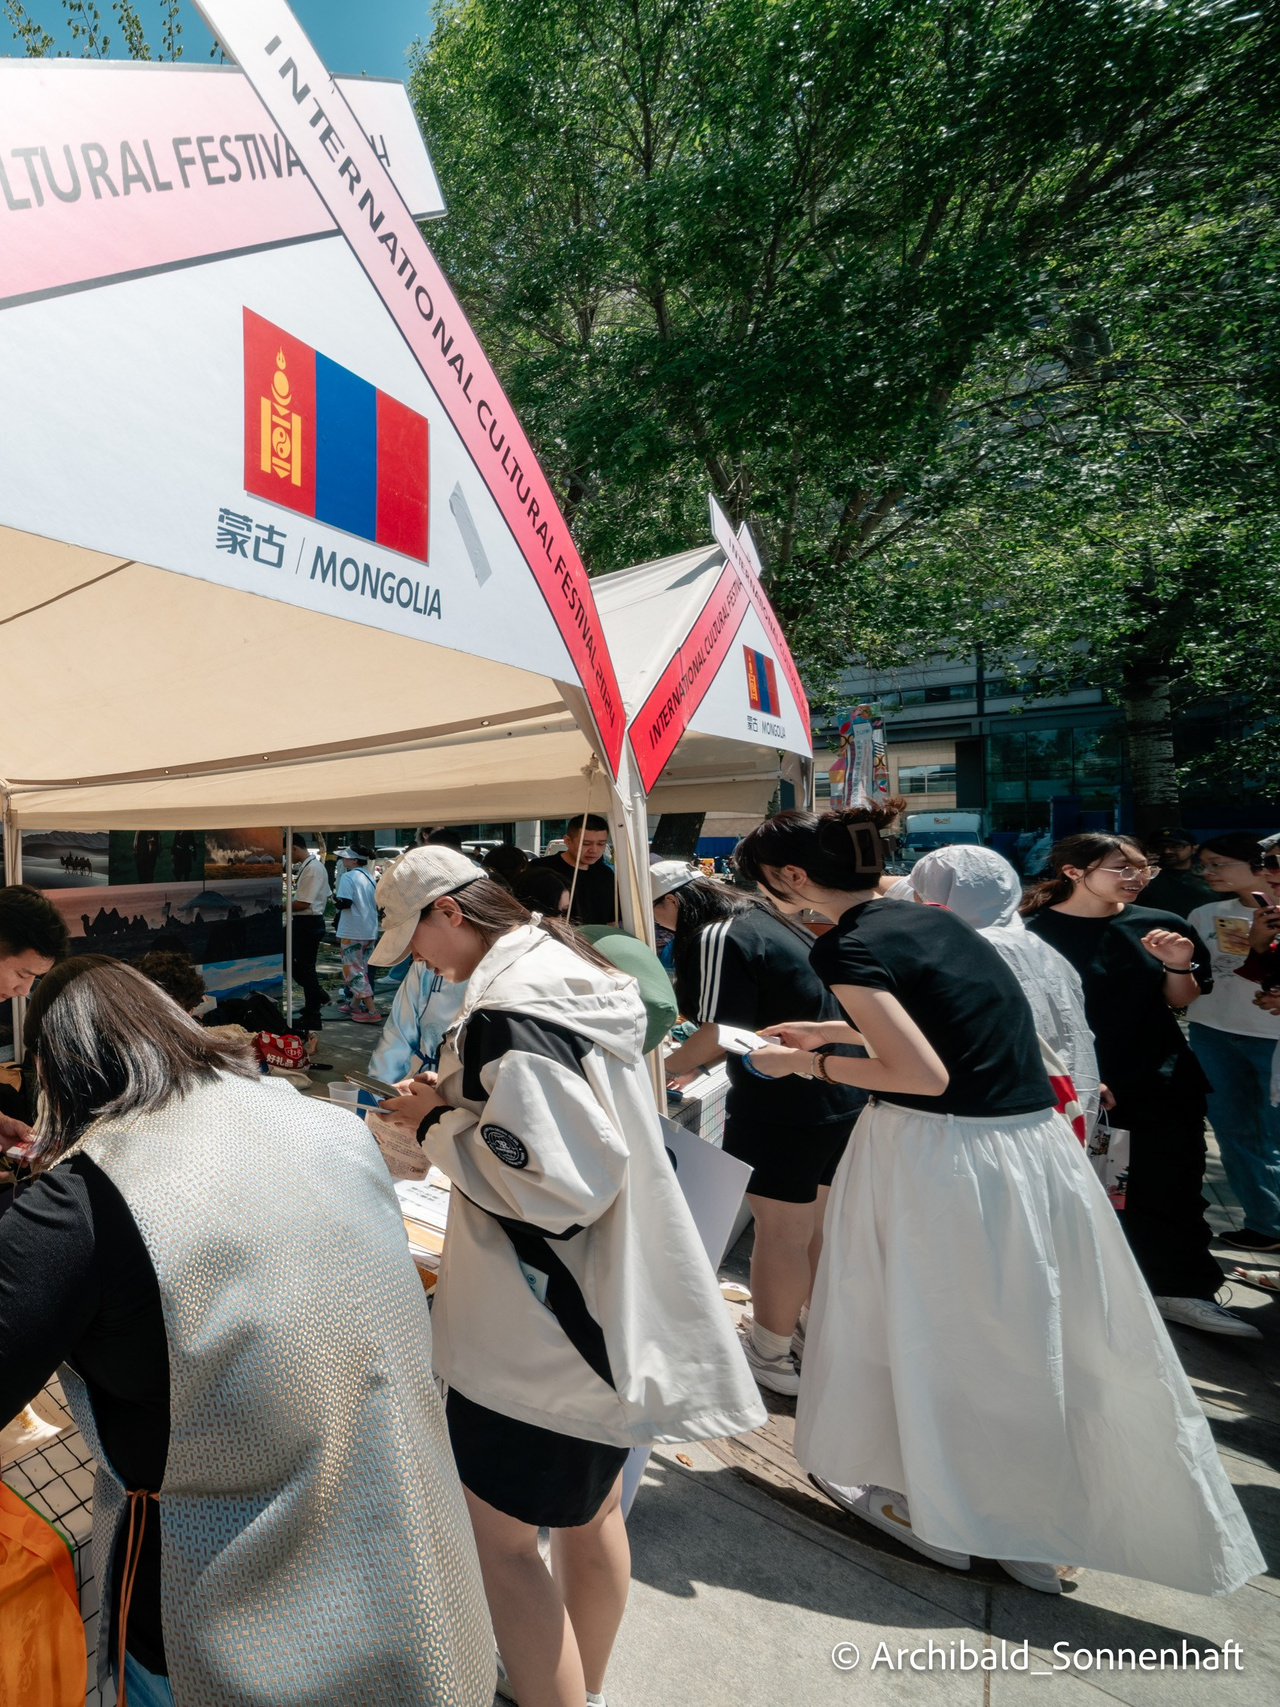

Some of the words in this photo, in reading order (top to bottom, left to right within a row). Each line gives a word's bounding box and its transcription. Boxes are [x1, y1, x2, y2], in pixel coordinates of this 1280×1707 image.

[173, 132, 308, 189] FESTIVA
[264, 35, 474, 403] INTERNATIONAL
[476, 399, 555, 564] CULTURAL
[554, 554, 598, 670] FESTIVAL
[215, 507, 288, 570] 蒙古
[310, 546, 443, 622] MONGOLIA
[649, 648, 707, 750] INTERNATIONAL
[704, 601, 730, 656] CULTURAL
[761, 720, 787, 740] MONGOLIA
[266, 1053, 294, 1068] 好礼品
